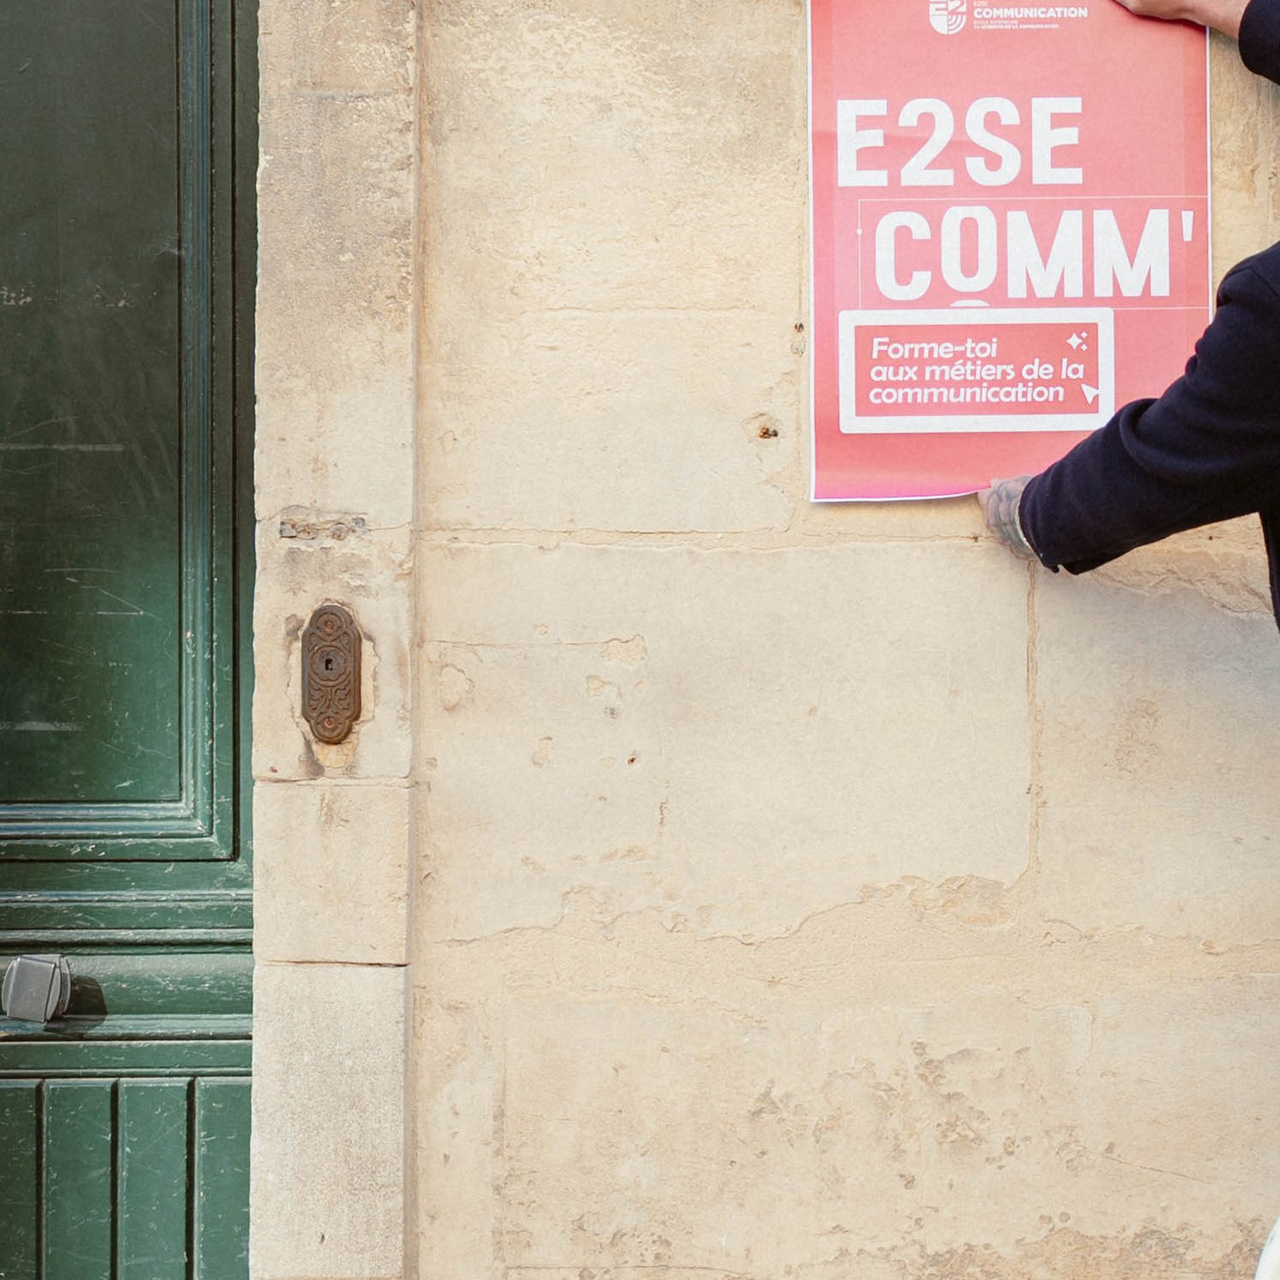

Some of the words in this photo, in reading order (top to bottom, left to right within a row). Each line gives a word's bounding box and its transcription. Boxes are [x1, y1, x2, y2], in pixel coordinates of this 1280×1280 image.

[973, 6, 1088, 19] COMMUNICATION
[836, 96, 1083, 187] E2SE
[874, 205, 1194, 301] COMM'
[871, 336, 998, 359] Forme-toi
[869, 365, 919, 382] aux
[924, 359, 1016, 381] métiers
[1021, 357, 1055, 380] de
[1060, 357, 1085, 380] la
[868, 381, 1065, 404] communication
